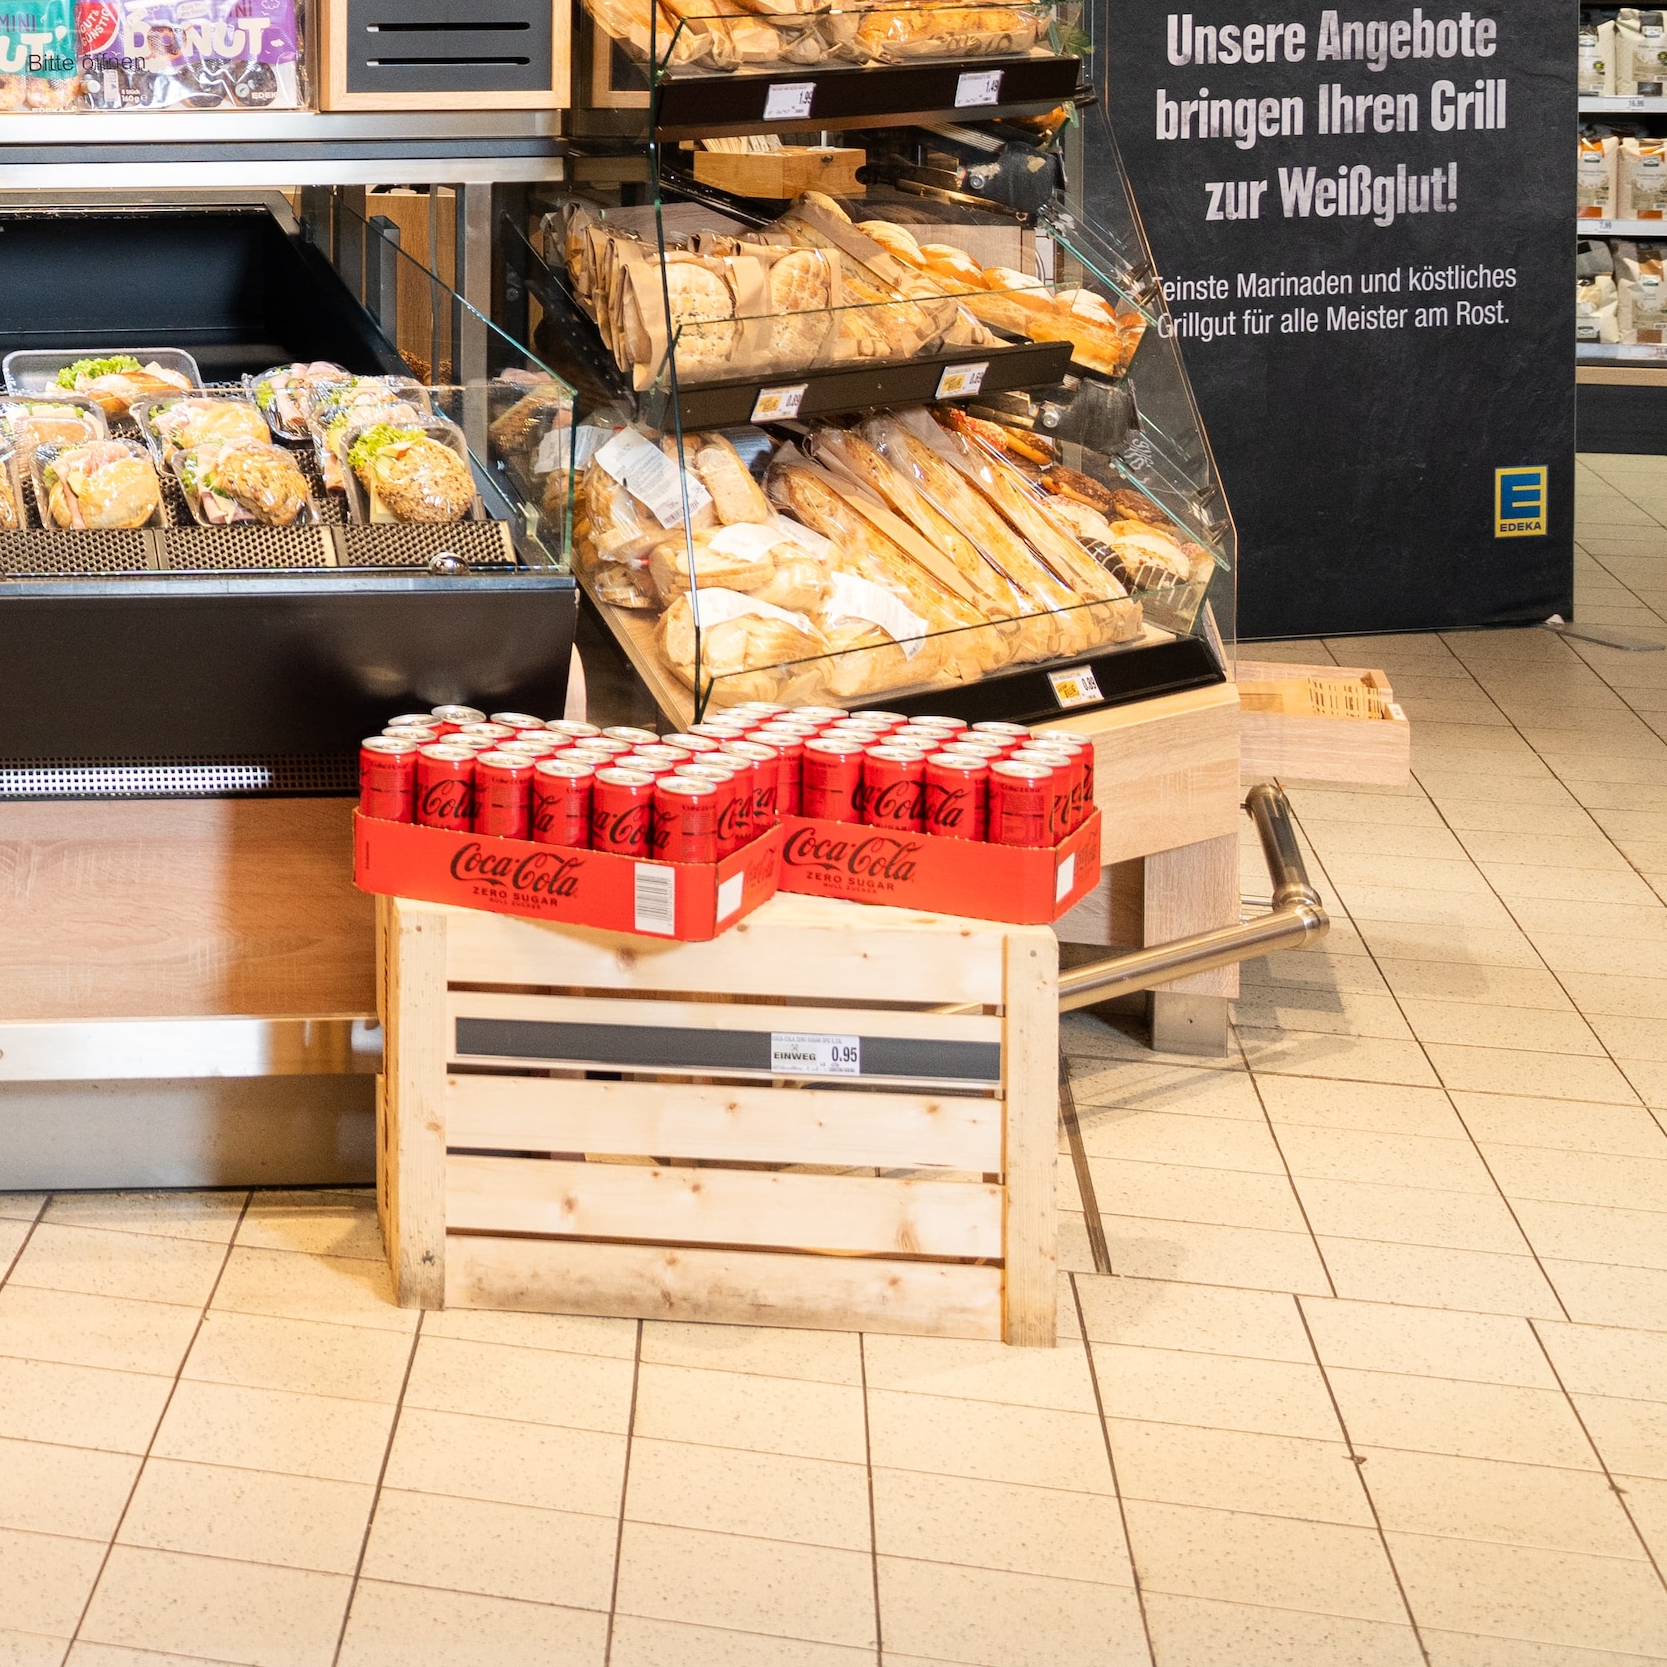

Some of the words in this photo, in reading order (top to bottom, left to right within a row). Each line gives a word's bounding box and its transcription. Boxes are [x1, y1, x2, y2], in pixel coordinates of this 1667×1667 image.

[1167, 14, 1307, 66] Unsere
[1316, 8, 1498, 73] Angebote
[28, 54, 74, 72] Bitte
[81, 53, 146, 72] öffnen
[985, 74, 997, 92] 1.49
[1156, 87, 1304, 150] bringen
[1318, 82, 1418, 135] Ihren
[1431, 78, 1507, 133] Grill
[1627, 99, 1644, 108] 16.99
[1205, 179, 1268, 221] zur
[1277, 161, 1458, 228] Weißglut!
[1598, 222, 1612, 230] 7.99
[1236, 270, 1353, 299] Marinaden
[1360, 267, 1402, 294] und
[1409, 264, 1517, 292] köstliches
[1157, 311, 1236, 343] Grillgut
[1242, 309, 1274, 335] für
[1280, 307, 1319, 333] alle
[1326, 304, 1408, 332] Meister
[1414, 307, 1448, 328] am
[1456, 299, 1510, 326] Rost.
[1499, 521, 1542, 532] EDEKA
[1081, 674, 1097, 690] 0.89
[783, 826, 924, 882] Coca-Cola
[450, 841, 584, 899] Coca-Cola
[805, 871, 842, 884] ZERO
[848, 877, 896, 892] SUGAR
[473, 885, 508, 899] ZERO
[513, 893, 558, 908] SUGAR
[773, 1053, 817, 1061] EINWEG
[831, 1046, 857, 1062] 0.95
